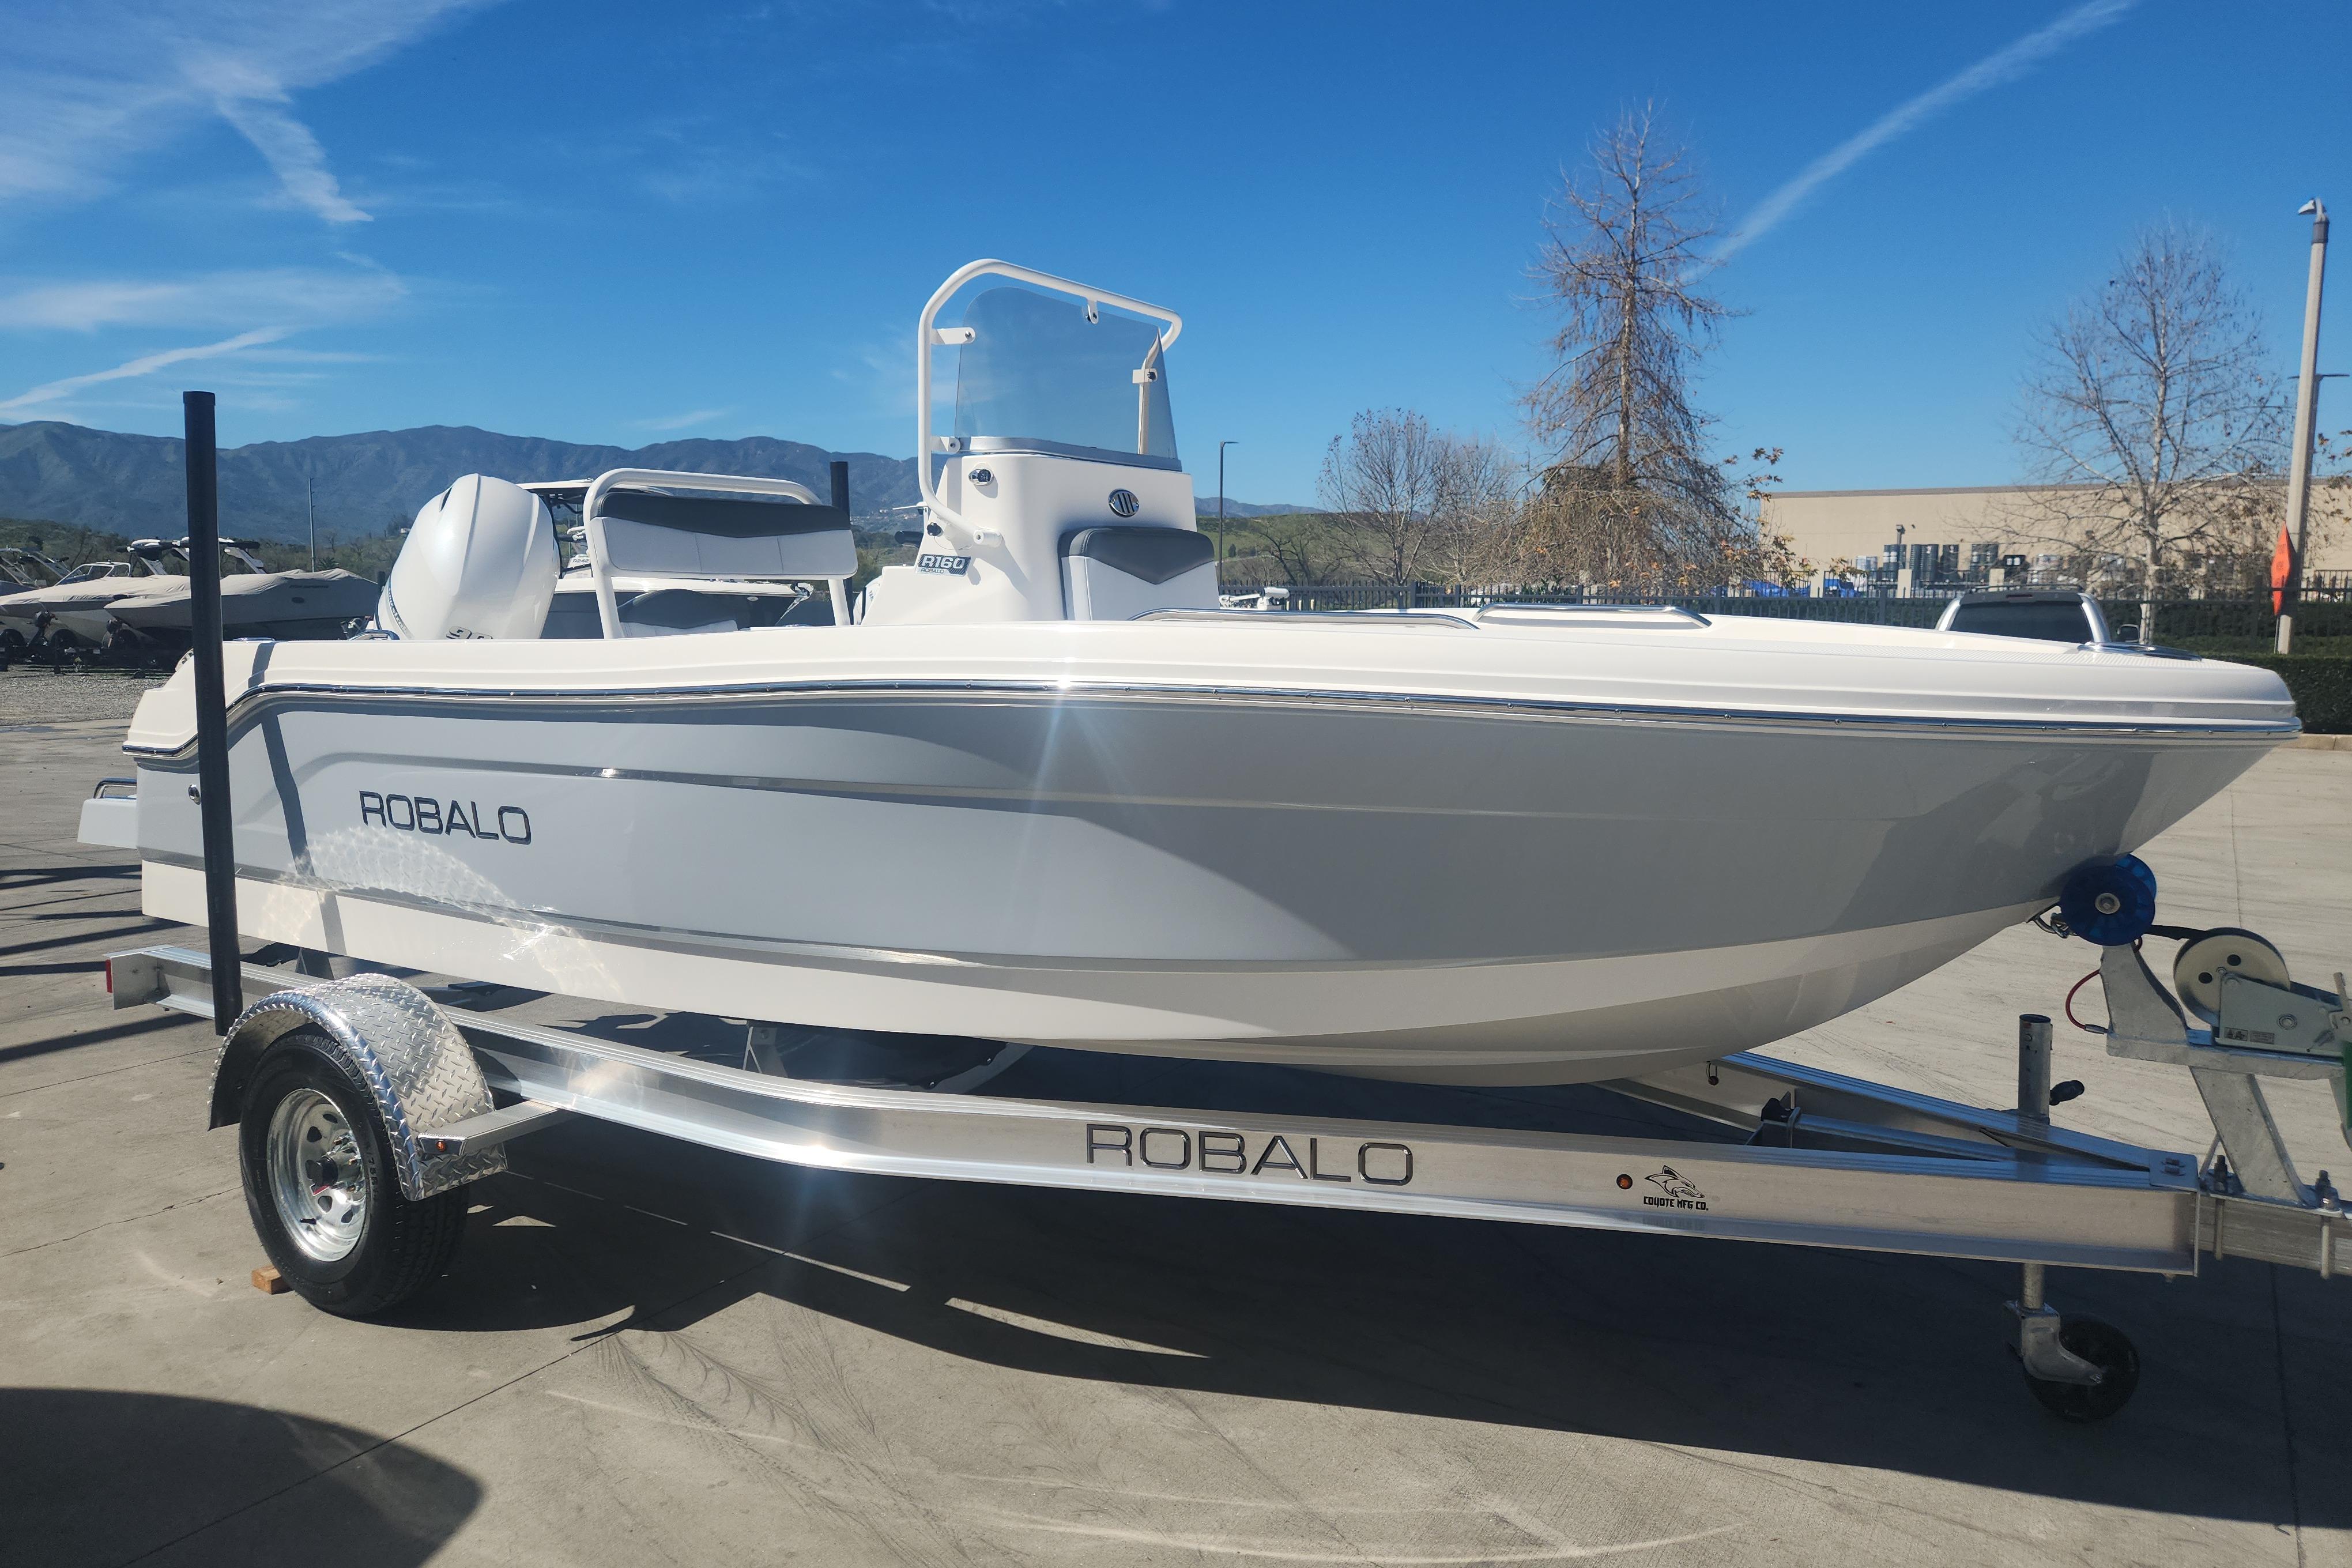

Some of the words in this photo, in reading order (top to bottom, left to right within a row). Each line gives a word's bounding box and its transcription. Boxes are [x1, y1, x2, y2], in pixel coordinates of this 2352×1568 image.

[921, 555, 966, 569] R160
[359, 790, 532, 845] ROBALO
[1086, 1123, 1414, 1186] ROBALO
[1644, 1196, 1675, 1208] COYOTE
[1677, 1199, 1693, 1210] MFG
[1695, 1201, 1709, 1211] CO.
